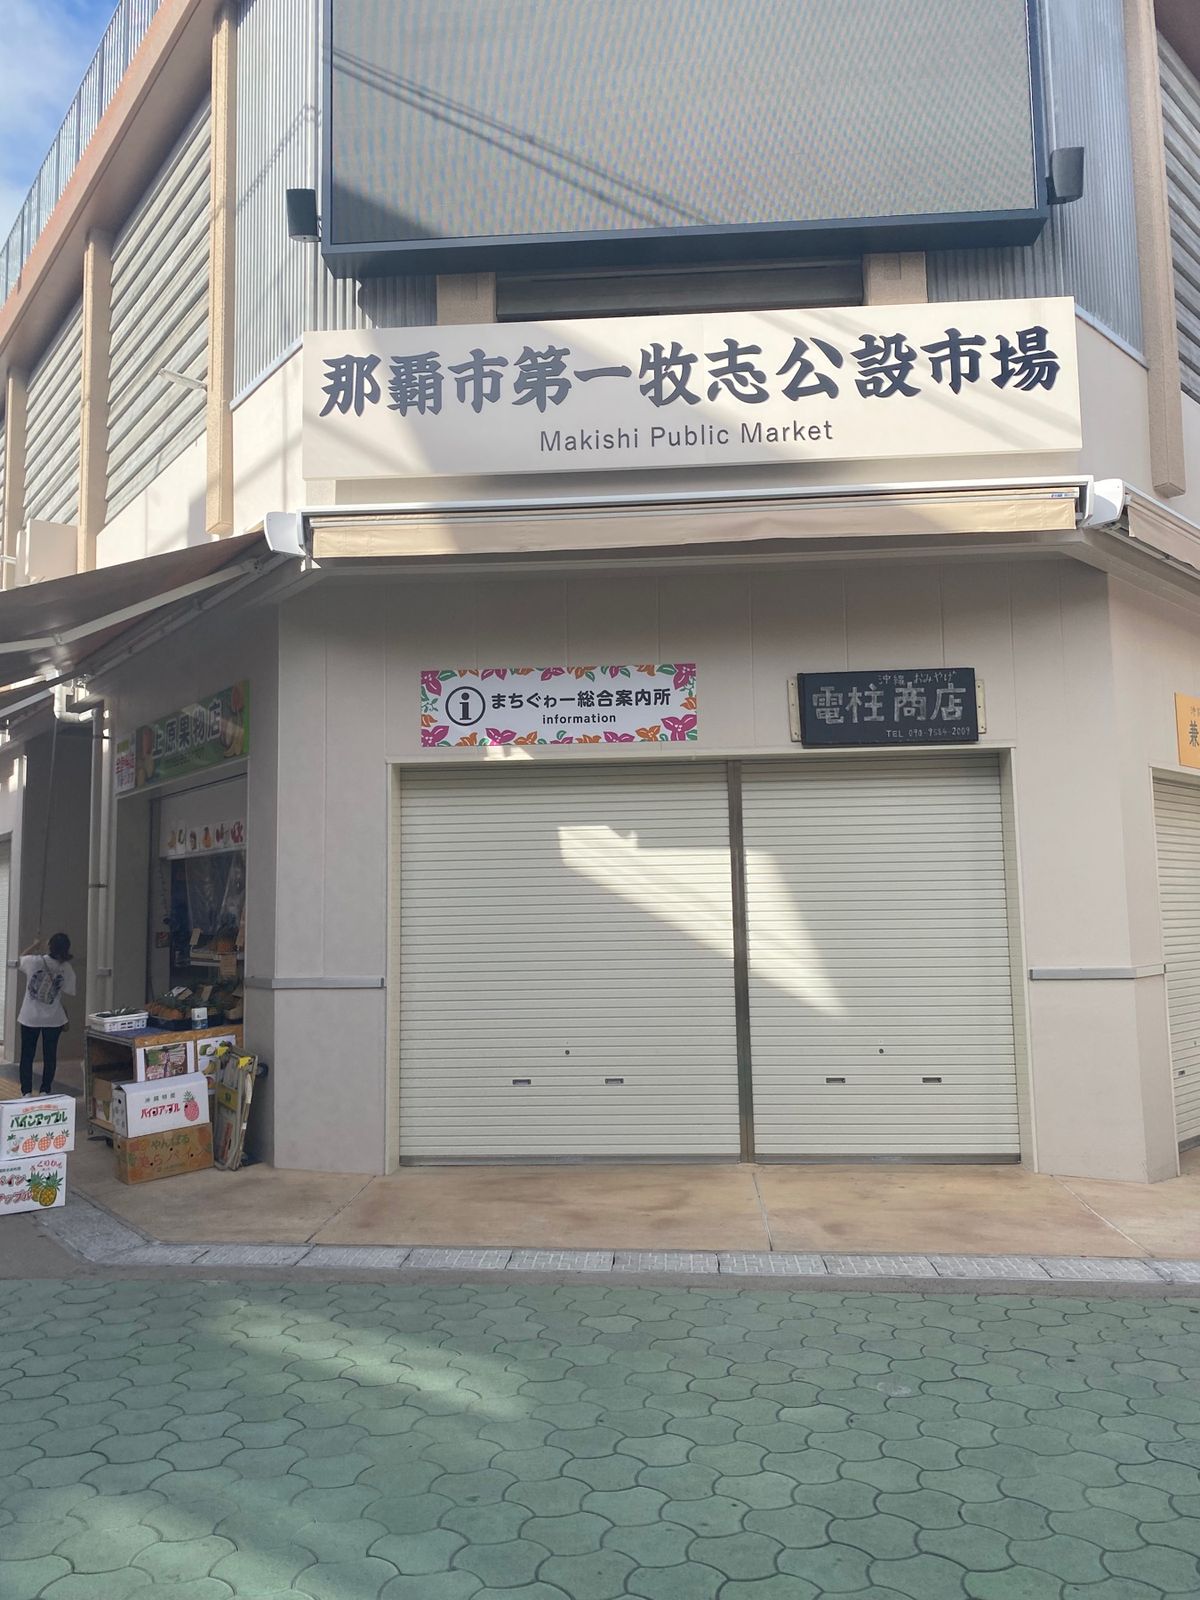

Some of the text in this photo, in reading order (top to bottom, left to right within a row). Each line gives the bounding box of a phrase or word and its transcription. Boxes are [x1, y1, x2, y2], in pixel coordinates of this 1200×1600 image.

[319, 325, 1063, 418] 那覇市第一牧志公設市場
[540, 419, 834, 452] Makishi Public Market
[812, 682, 967, 725] 電柱商店
[542, 713, 617, 725] information
[886, 729, 904, 738] TEL
[10, 1111, 68, 1128] パインアップル
